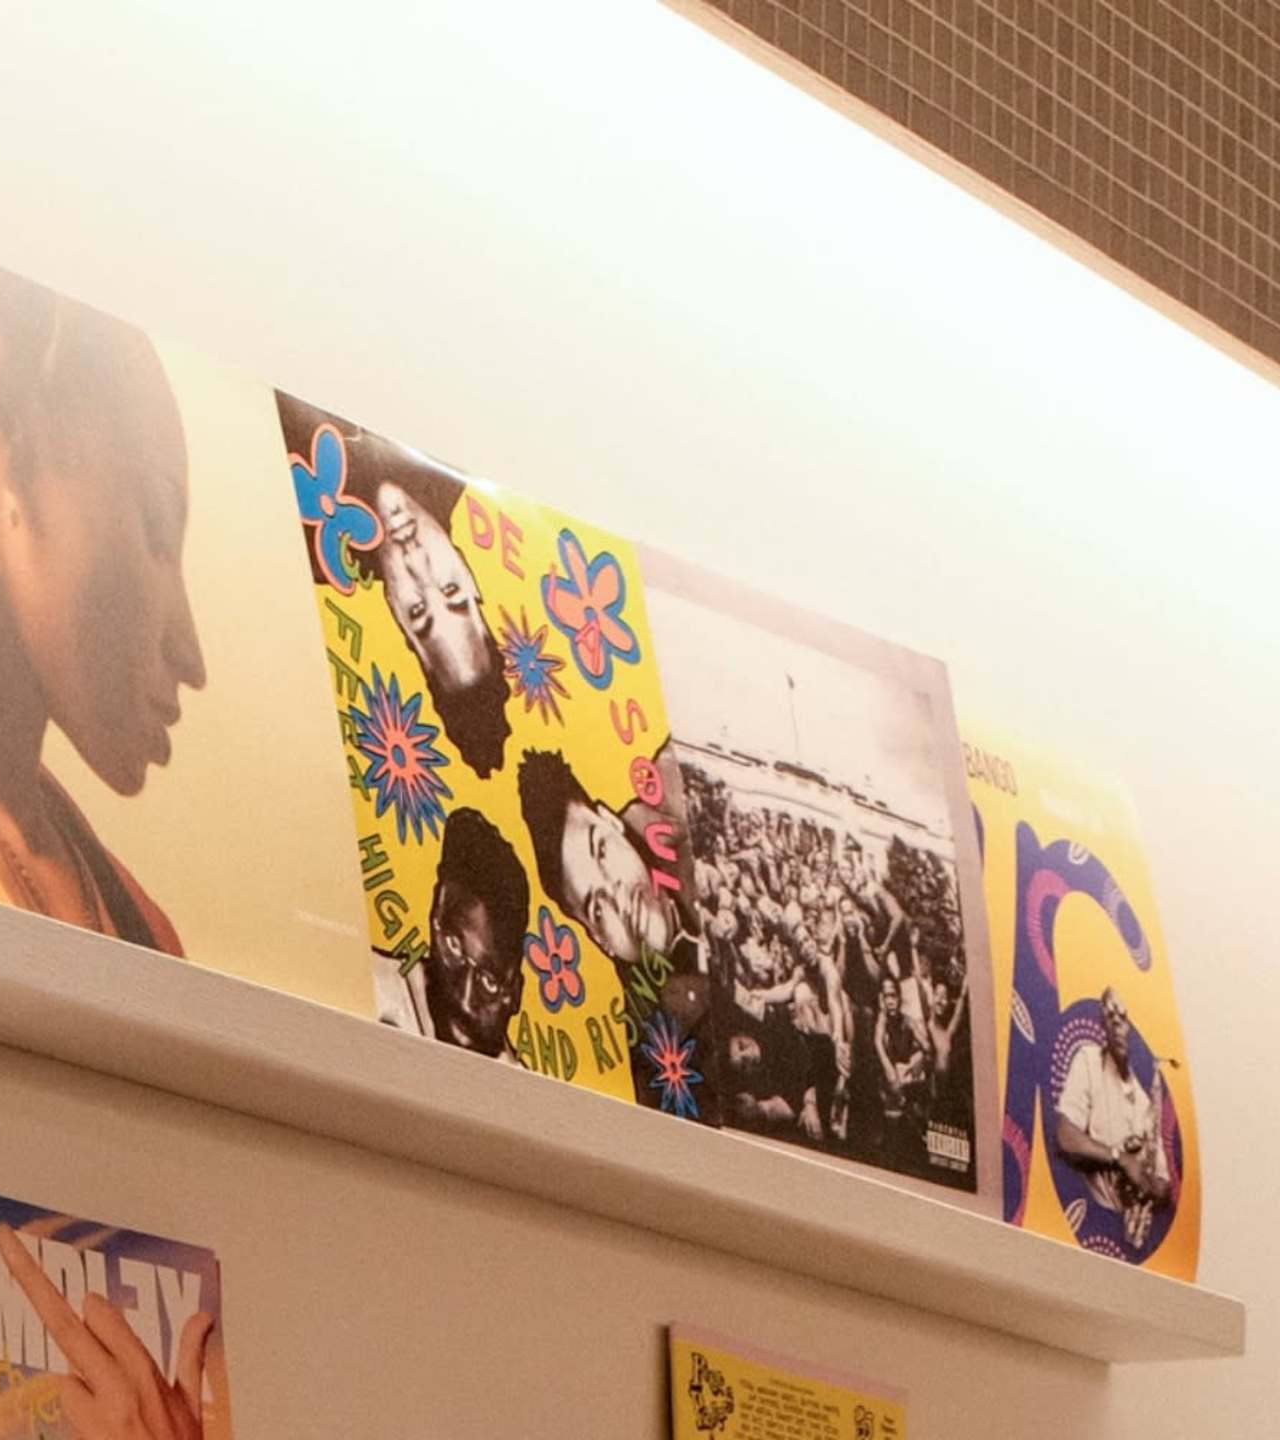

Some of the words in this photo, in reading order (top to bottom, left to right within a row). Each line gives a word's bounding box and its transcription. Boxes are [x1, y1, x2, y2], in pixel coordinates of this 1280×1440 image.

[466, 495, 524, 581] DE
[358, 833, 430, 977] HIGH
[516, 1009, 578, 1081] AND
[586, 940, 674, 1074] RISING
